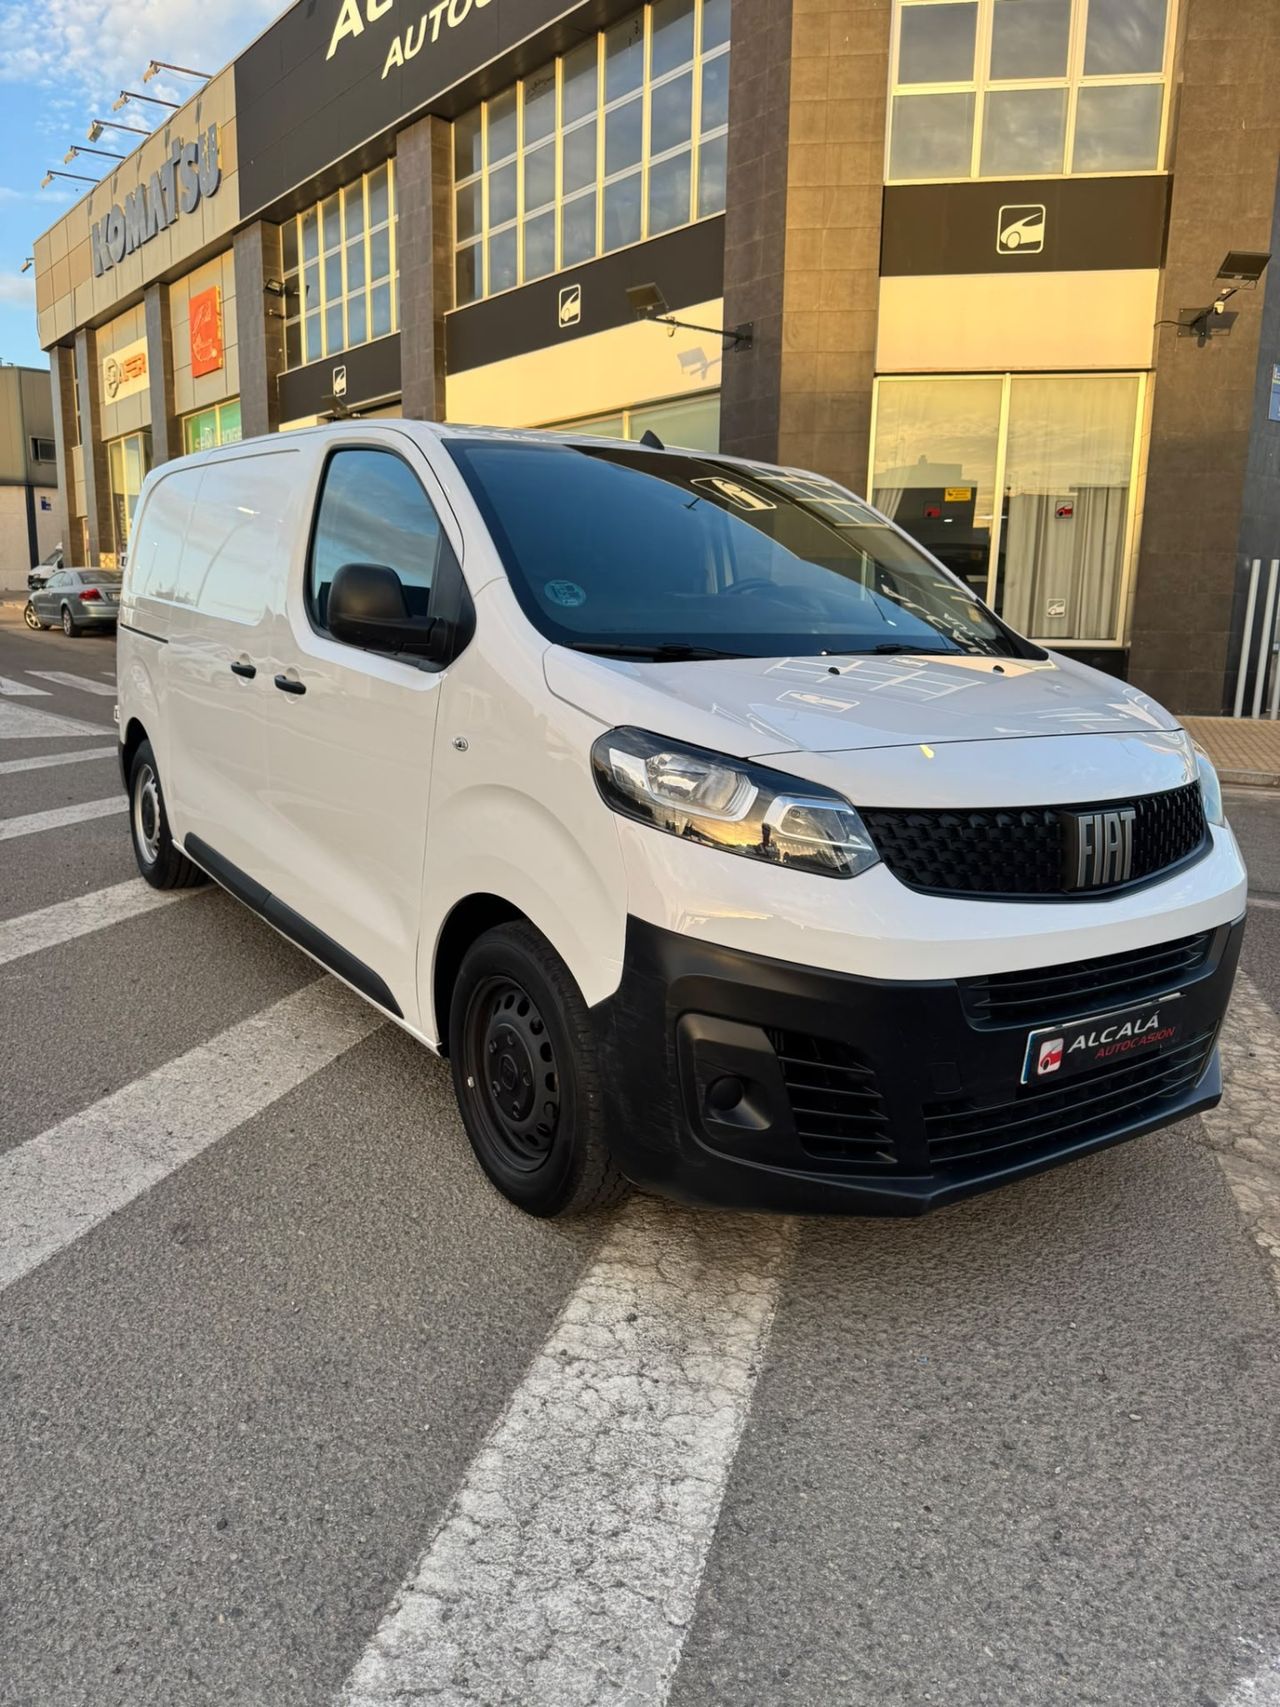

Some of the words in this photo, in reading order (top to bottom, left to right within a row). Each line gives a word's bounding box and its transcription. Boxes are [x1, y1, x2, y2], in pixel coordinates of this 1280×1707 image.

[381, 0, 492, 80] AUTO
[92, 122, 221, 277] KOMATSU
[1077, 811, 1136, 888] FIAT
[1067, 1010, 1160, 1054] ALCALÁ
[1095, 1027, 1175, 1060] AUTOCASION
